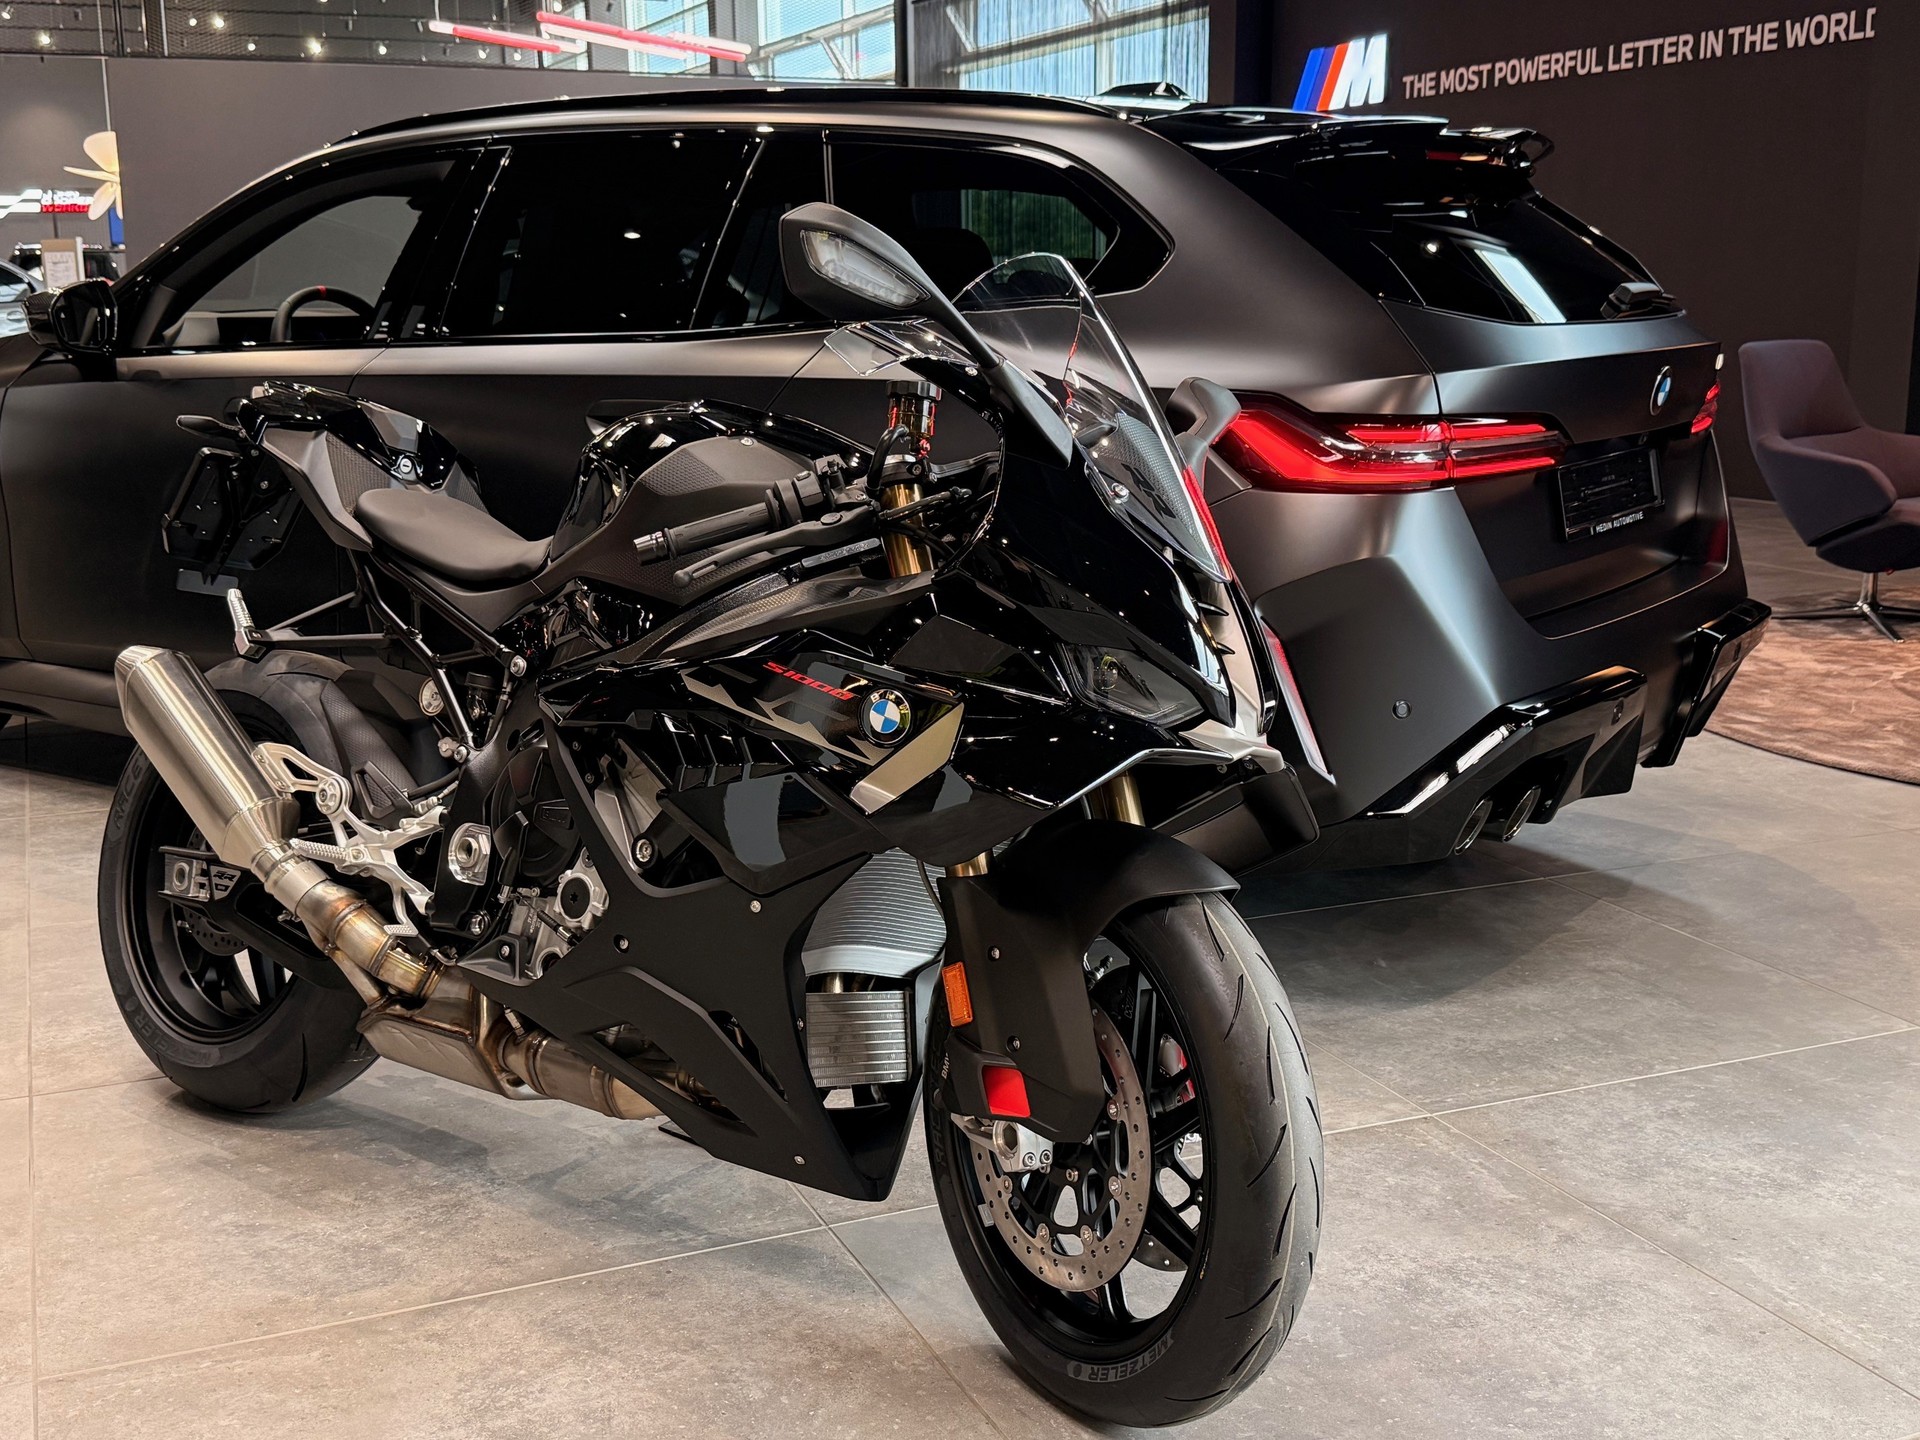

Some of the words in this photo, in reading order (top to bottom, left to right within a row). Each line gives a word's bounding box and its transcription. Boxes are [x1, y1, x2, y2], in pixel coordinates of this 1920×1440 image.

[1326, 33, 1387, 111] M
[1402, 71, 1437, 100] THE
[1439, 62, 1492, 95] MOST
[1494, 47, 1603, 88] POWERFUL
[1607, 33, 1694, 72] LETTER
[1699, 29, 1724, 60] IN
[1727, 21, 1779, 55] THE
[1613, 511, 1644, 528] AUTOMOTIVE
[870, 689, 910, 714] BMW
[1087, 1337, 1169, 1381] METZELER
